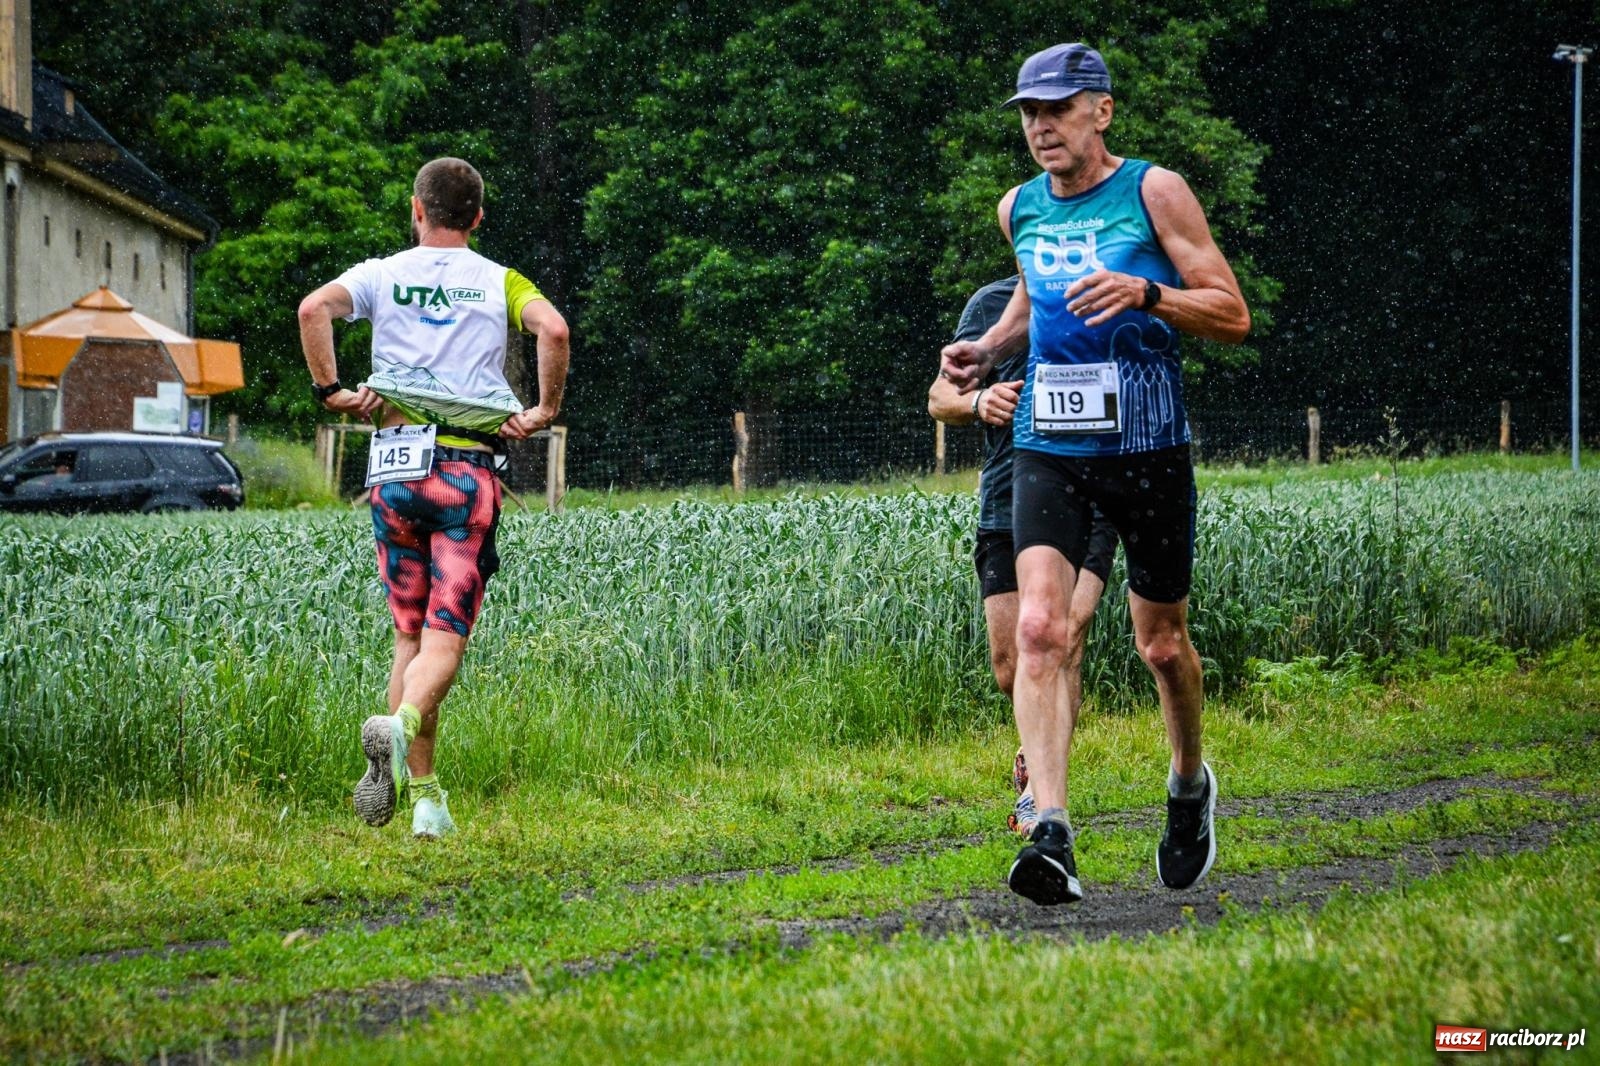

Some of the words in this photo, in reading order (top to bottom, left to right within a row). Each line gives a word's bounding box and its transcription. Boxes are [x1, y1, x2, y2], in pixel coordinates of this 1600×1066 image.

[393, 283, 451, 311] UTA
[452, 290, 481, 299] TEAM
[1048, 391, 1084, 414] 119
[379, 447, 410, 468] 145
